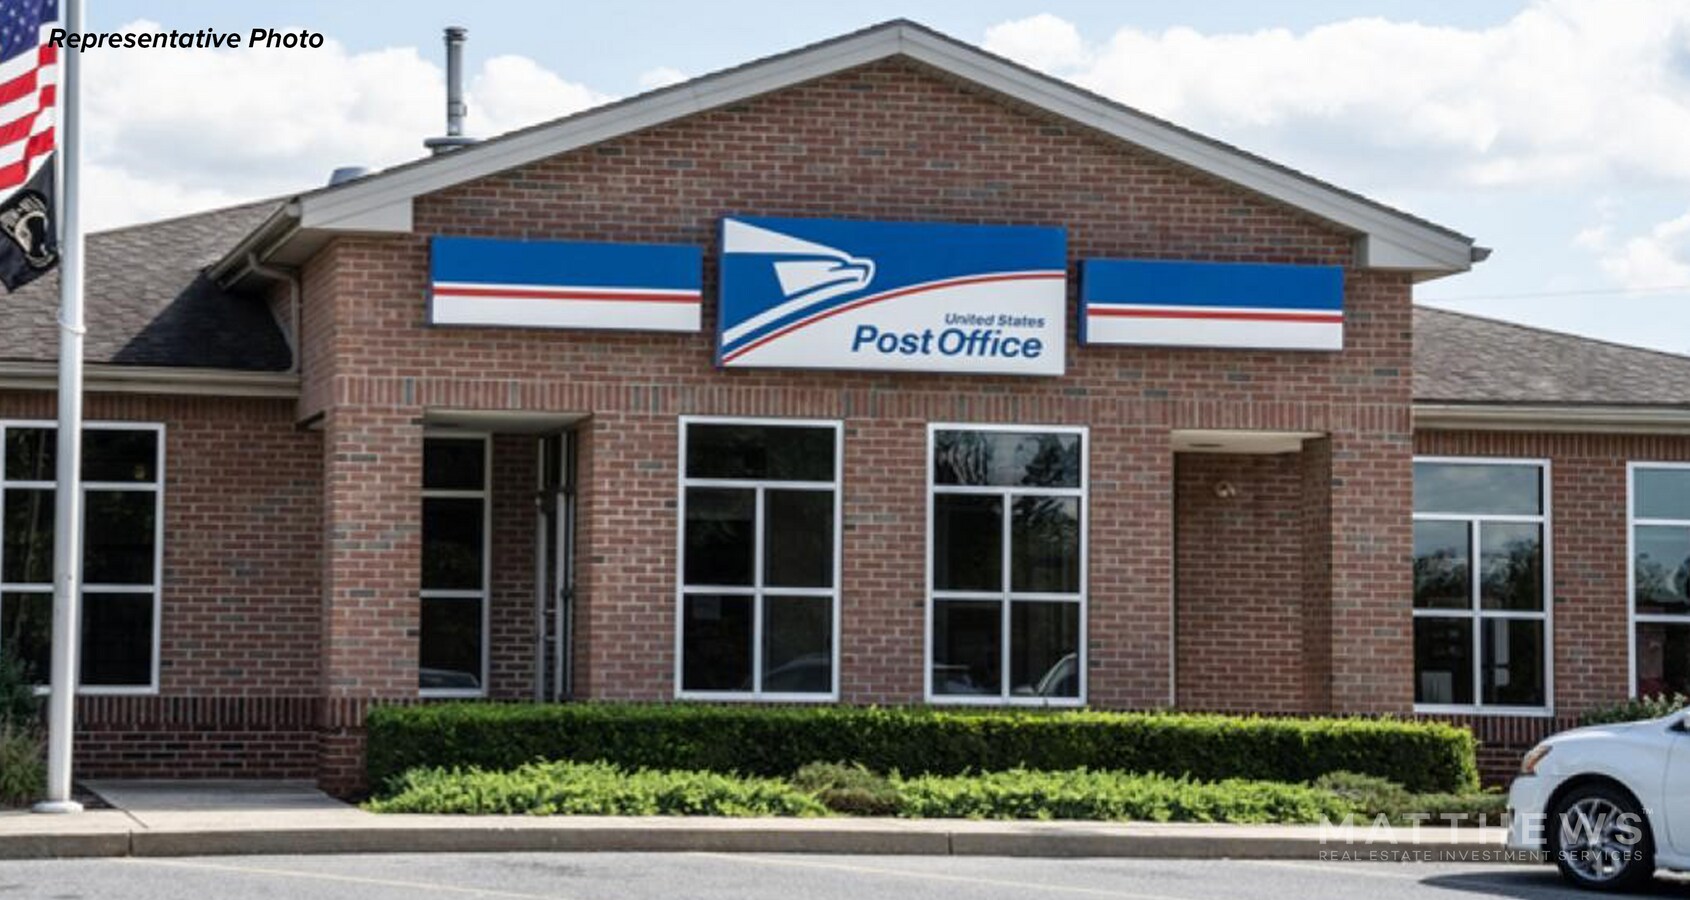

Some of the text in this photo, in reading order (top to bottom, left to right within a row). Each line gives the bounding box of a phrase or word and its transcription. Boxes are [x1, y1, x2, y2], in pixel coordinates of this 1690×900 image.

[944, 312, 1045, 328] United States
[851, 324, 1043, 358] Post Office
